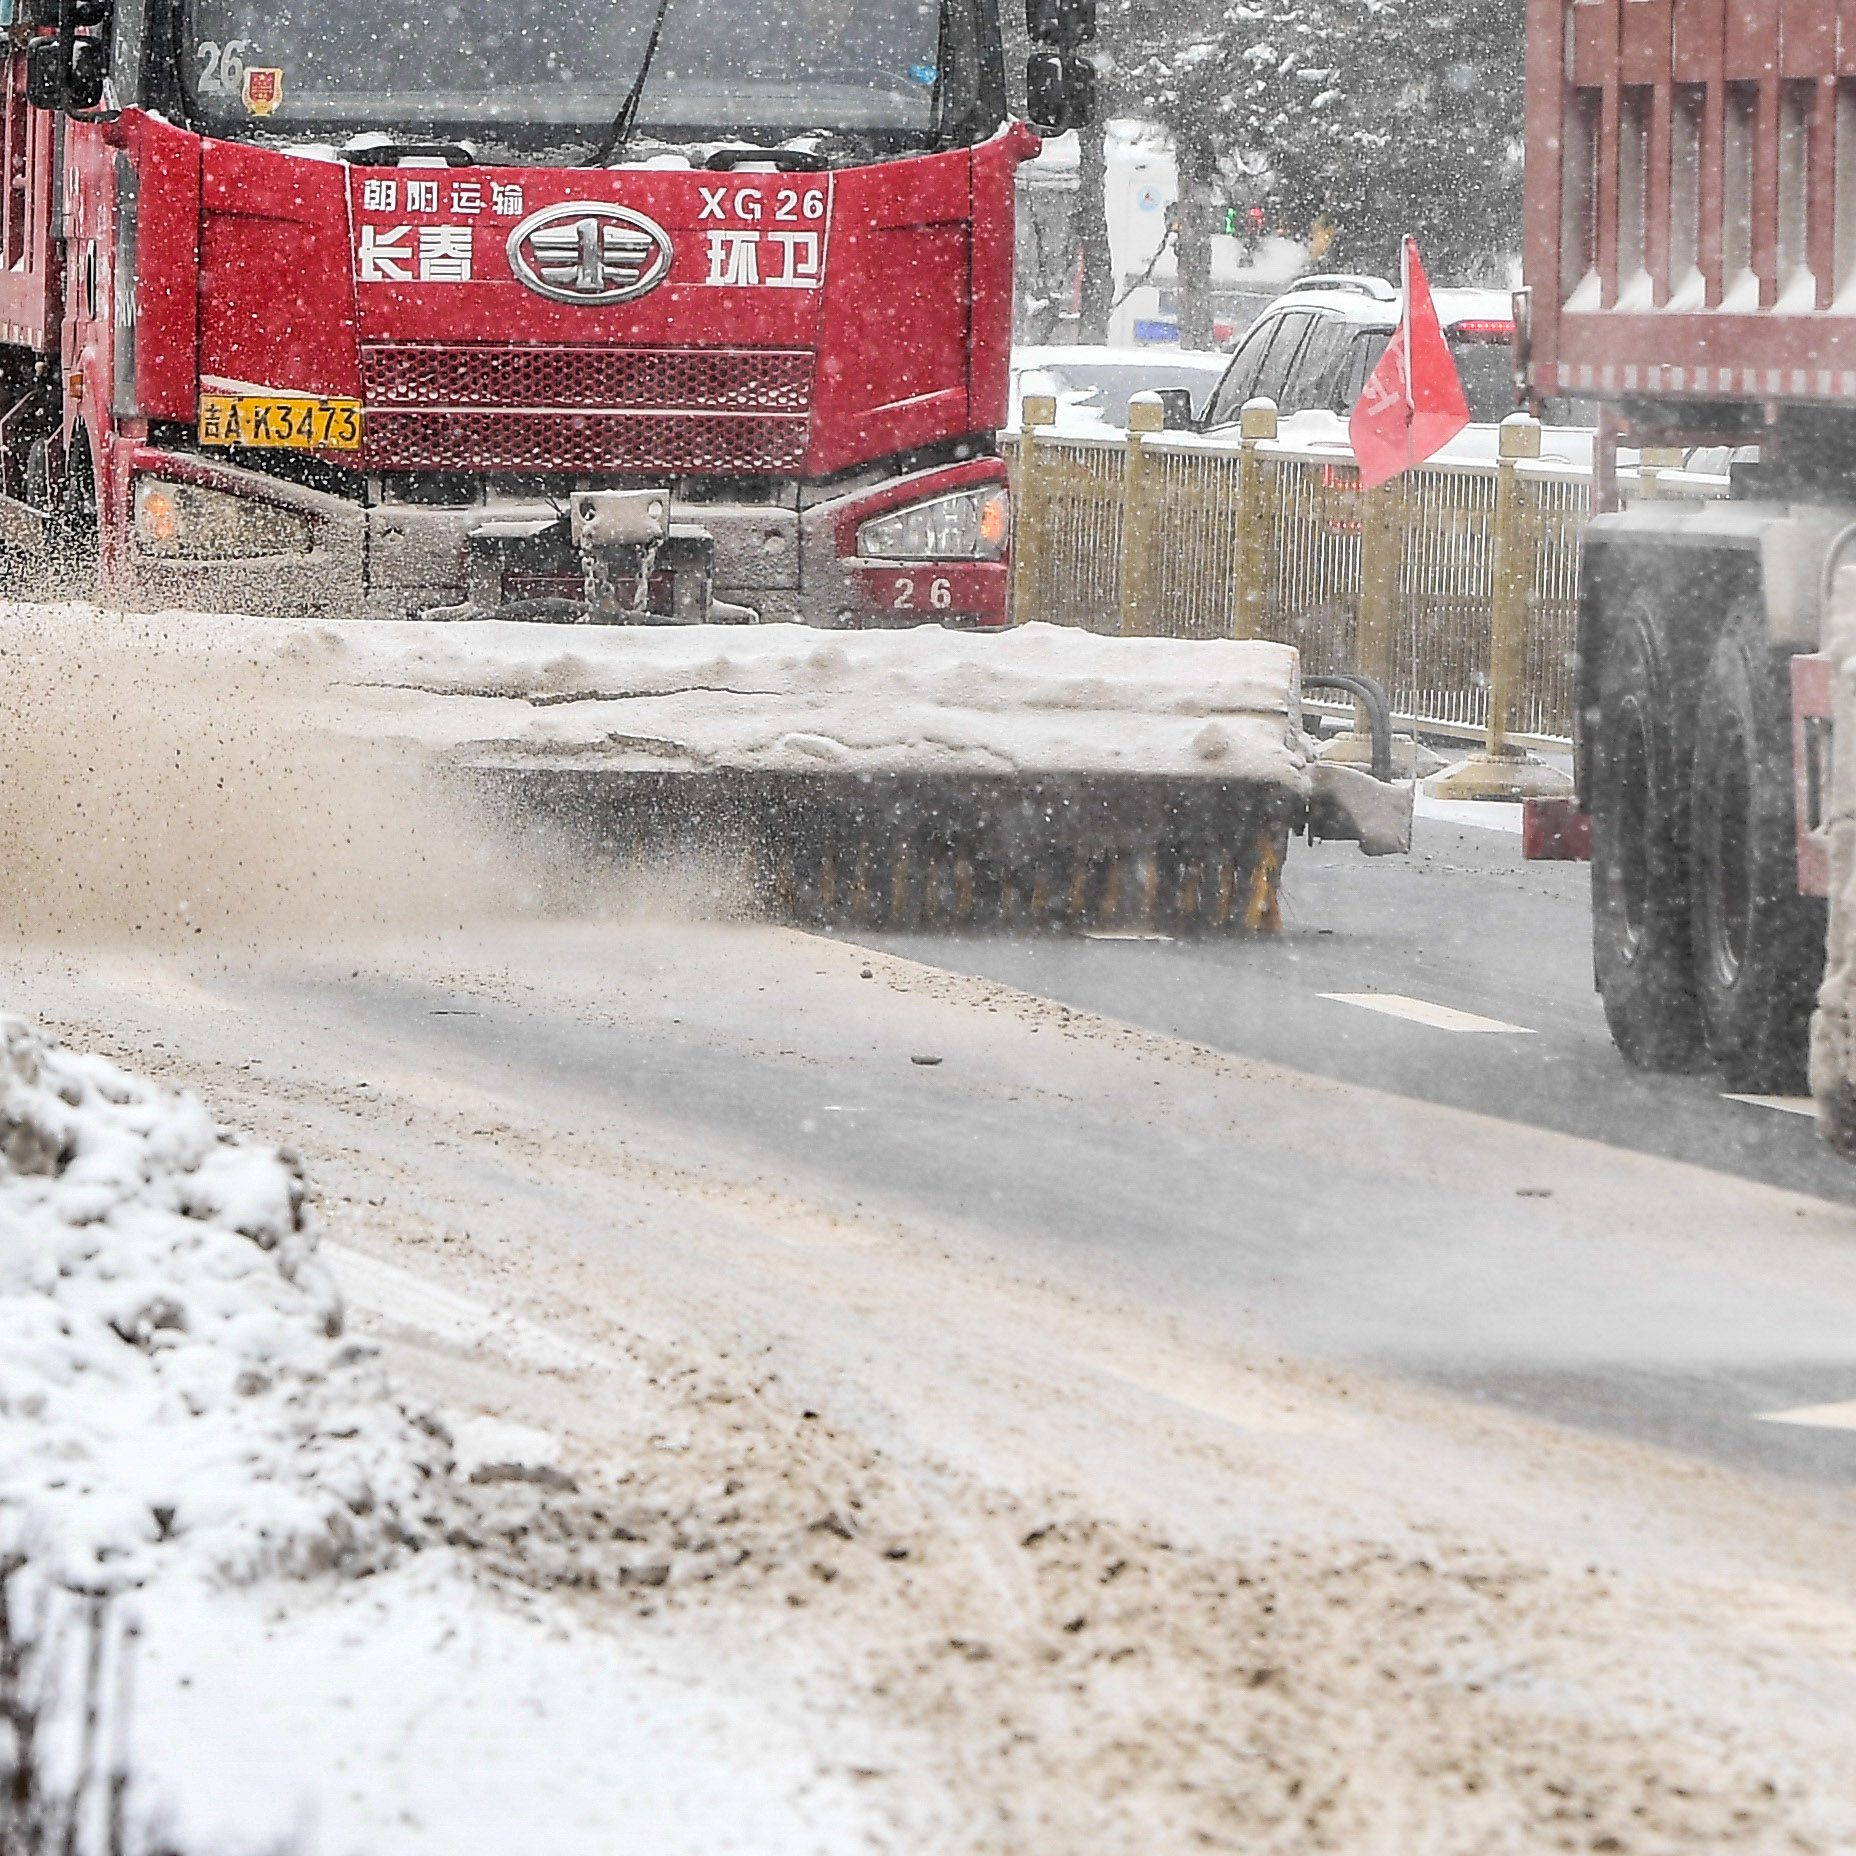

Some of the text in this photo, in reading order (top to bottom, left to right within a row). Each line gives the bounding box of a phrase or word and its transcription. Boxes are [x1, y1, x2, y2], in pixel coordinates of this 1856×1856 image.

[197, 39, 246, 93] 26
[363, 179, 524, 217] 朝阳运输
[359, 224, 821, 287] 长春 环卫
[893, 577, 952, 610] 26
